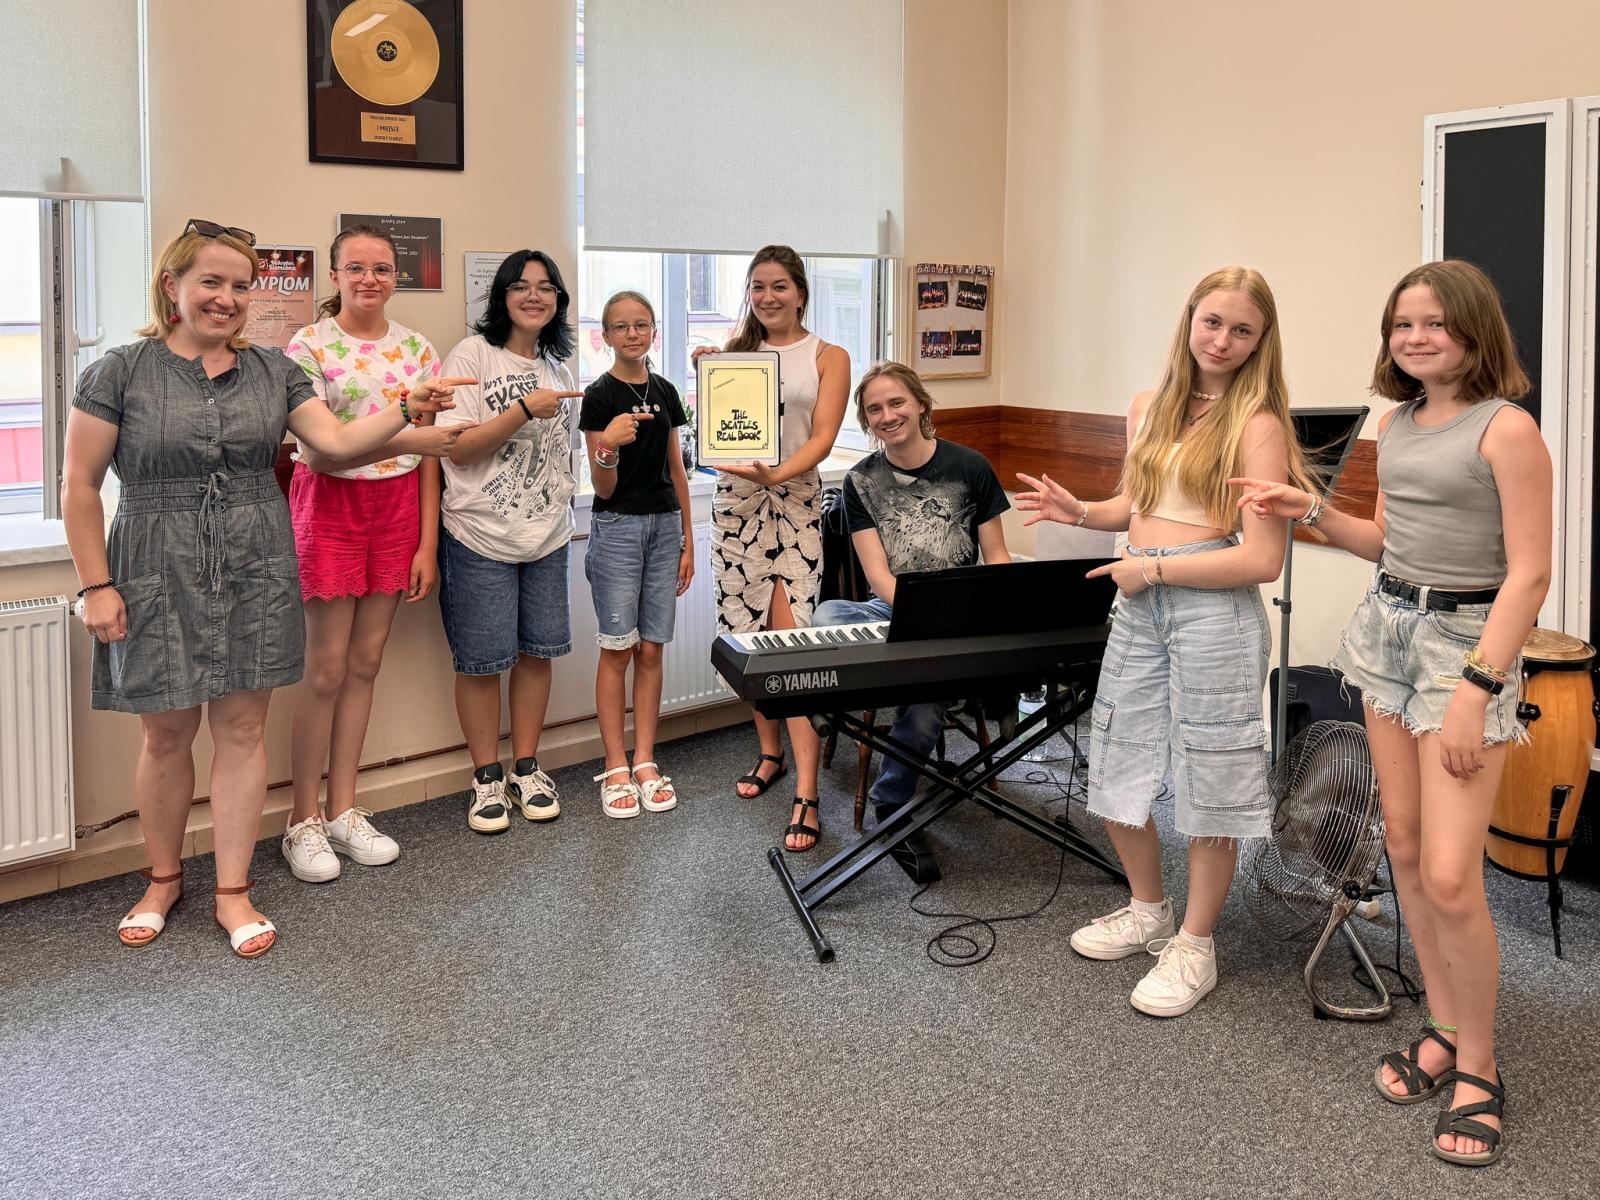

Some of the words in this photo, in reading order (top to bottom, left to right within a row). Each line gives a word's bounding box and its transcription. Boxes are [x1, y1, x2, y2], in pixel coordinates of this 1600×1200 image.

[484, 376, 503, 391] JUST
[731, 409, 748, 420] THE
[720, 420, 759, 431] BEATLES
[716, 430, 737, 441] REAL
[738, 430, 762, 441] BOOK
[481, 471, 507, 493] CONTEST
[783, 670, 839, 691] YAMAHA
